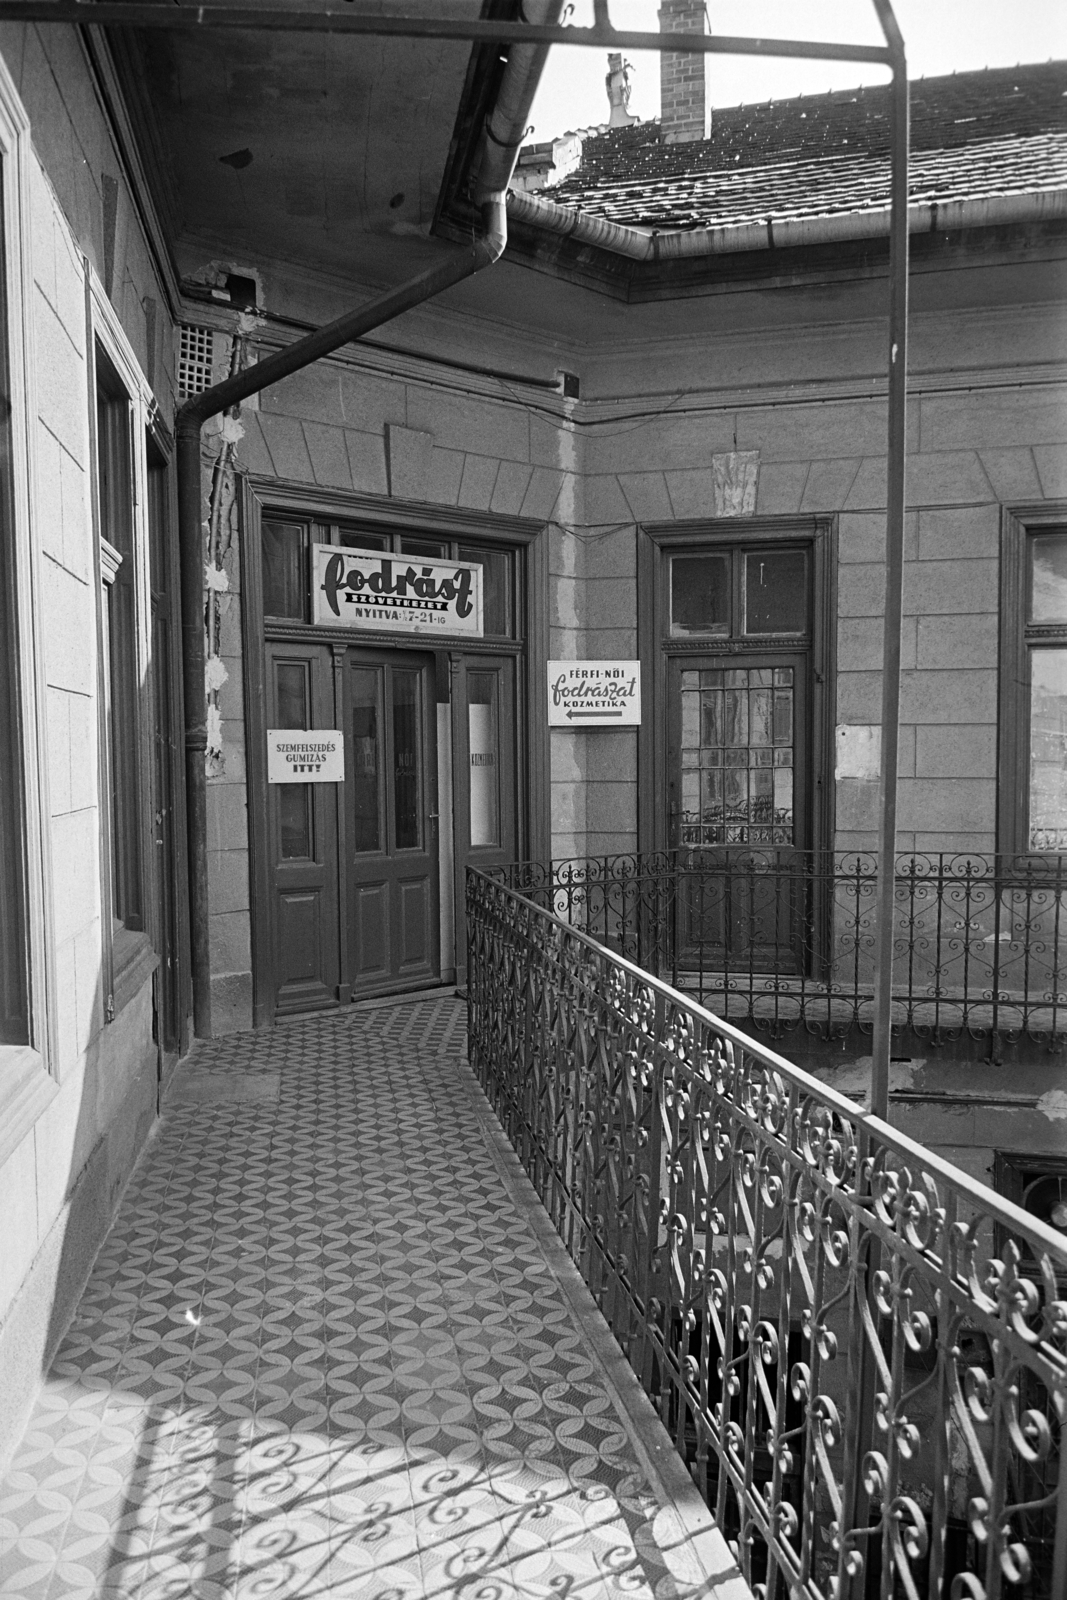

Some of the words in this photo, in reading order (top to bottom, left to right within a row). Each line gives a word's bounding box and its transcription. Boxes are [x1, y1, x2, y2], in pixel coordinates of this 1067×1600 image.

[351, 594, 443, 610] SZÖVETKEZET
[355, 607, 402, 620] NYITVA:
[569, 667, 625, 679] FÉRFI-NŐI
[551, 674, 637, 706] fodrászat
[563, 700, 627, 708] KOZMETIKA
[276, 741, 336, 752] SZEMFELSZEDÉS
[285, 752, 327, 763] GUMIZÁS
[293, 764, 322, 773] ITT!
